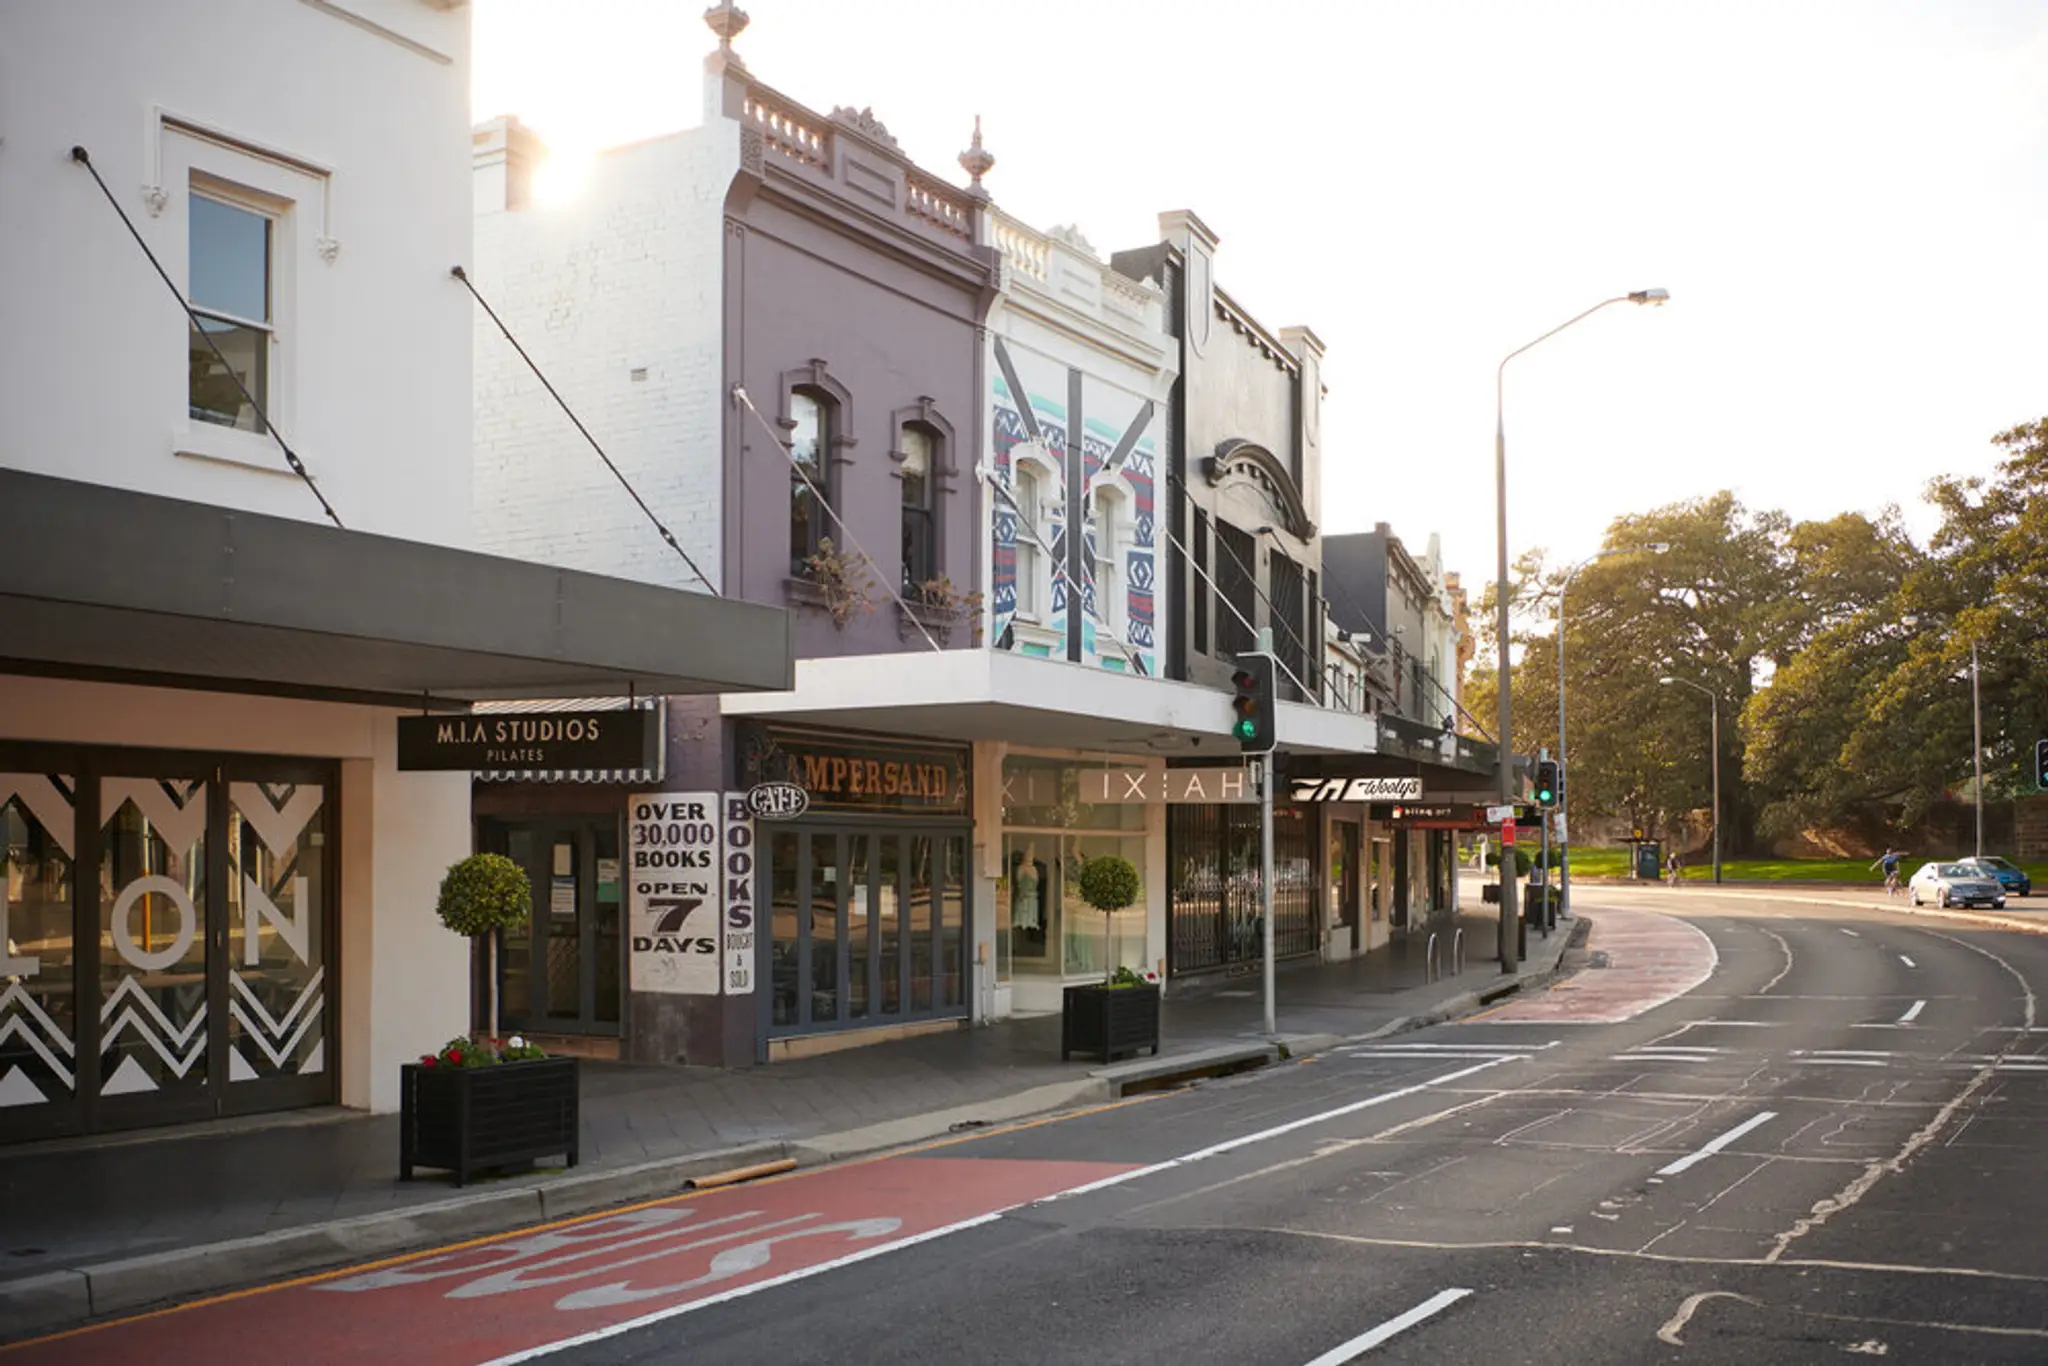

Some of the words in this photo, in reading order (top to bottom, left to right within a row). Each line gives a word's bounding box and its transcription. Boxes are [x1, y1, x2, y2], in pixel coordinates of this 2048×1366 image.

[495, 718, 600, 742] STUDIOS
[486, 749, 544, 762] PILATES
[786, 754, 947, 798] AMPERSAND
[636, 803, 705, 821] OVER
[632, 823, 714, 848] 30,000
[634, 850, 711, 868] BOOKS
[727, 800, 753, 929] BOOKS
[636, 882, 708, 895] OPEN
[646, 898, 703, 936] 7
[633, 937, 716, 954] DAYS
[308, 1208, 902, 1310] BUS
